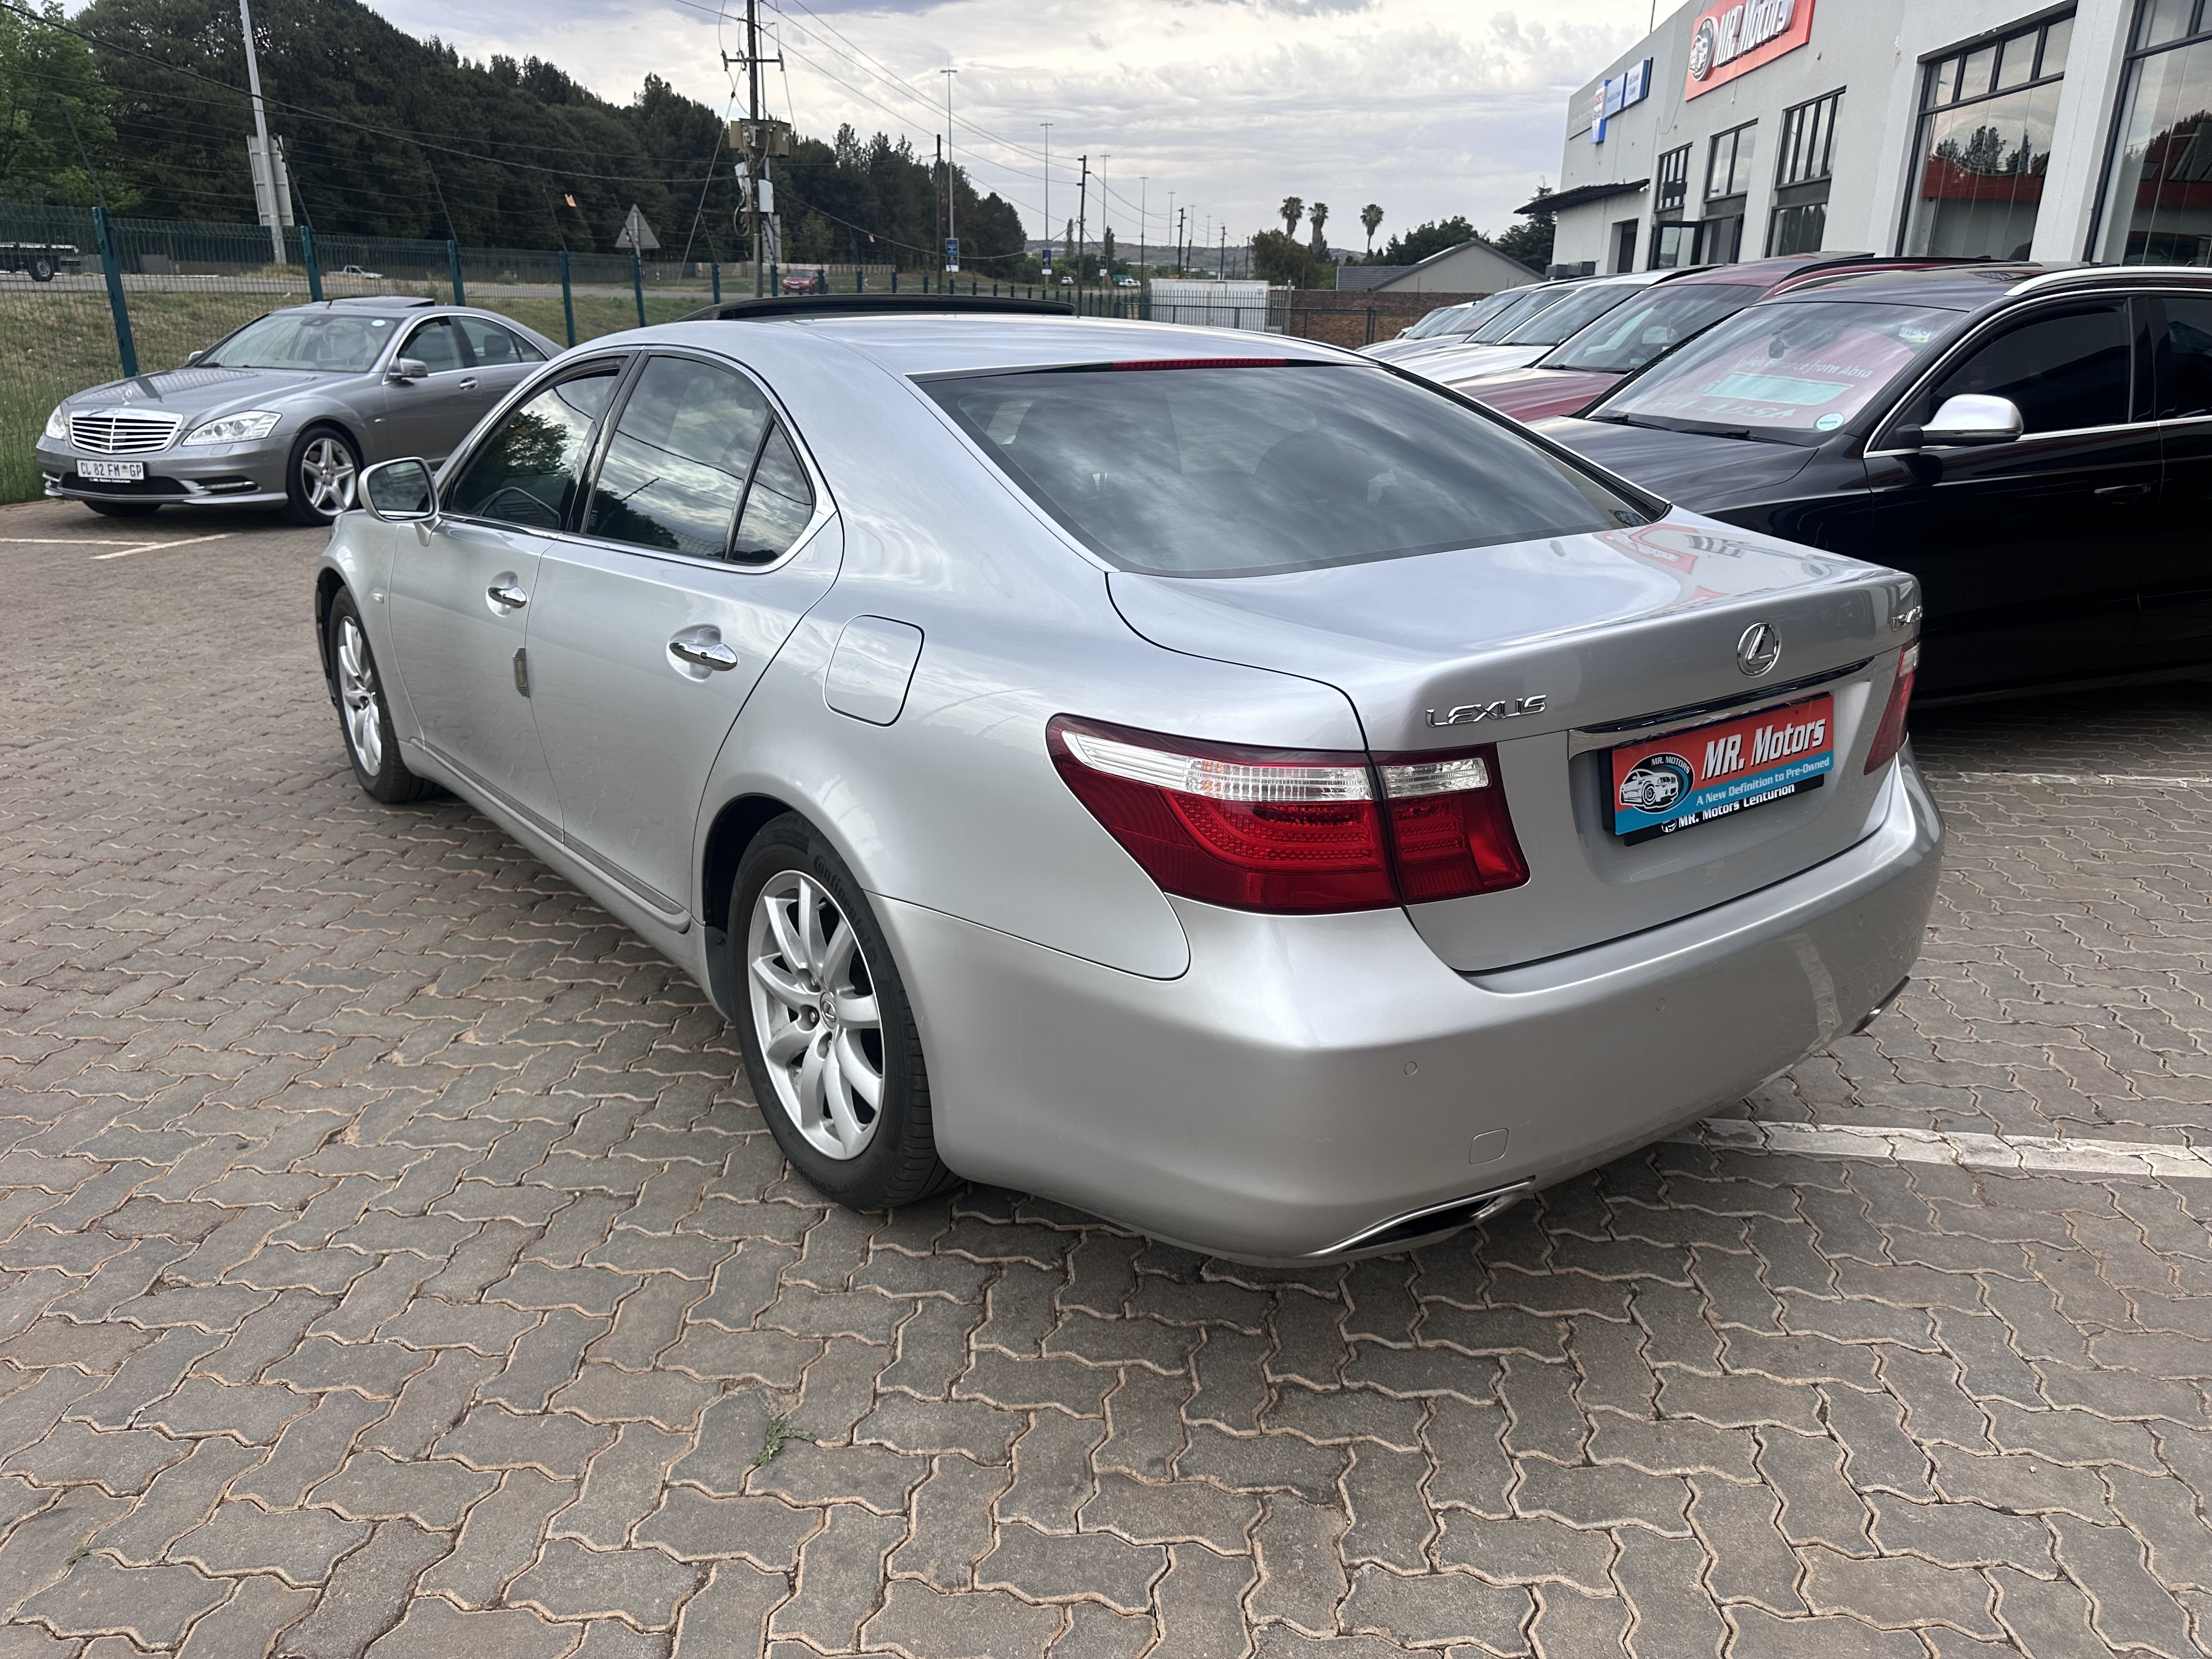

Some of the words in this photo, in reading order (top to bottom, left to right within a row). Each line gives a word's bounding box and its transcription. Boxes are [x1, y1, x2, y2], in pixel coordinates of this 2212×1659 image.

[1802, 360, 1841, 375] from
[1837, 364, 1874, 379] Absa
[81, 462, 91, 476] CL
[94, 463, 105, 476] 82
[129, 465, 142, 477] GP
[1426, 694, 1547, 728] LEXUS
[1701, 733, 1746, 781] MR.
[1750, 718, 1827, 766] Motors
[1651, 757, 1664, 766] MR.
[1664, 756, 1691, 774] MOTORS
[1696, 796, 1704, 806] A
[1706, 790, 1727, 804] New
[1728, 777, 1774, 797] Definition
[1774, 773, 1784, 782] to
[1786, 757, 1830, 780] Pre-Owned
[1678, 813, 1700, 828] MR.
[1702, 800, 1740, 821] Motors
